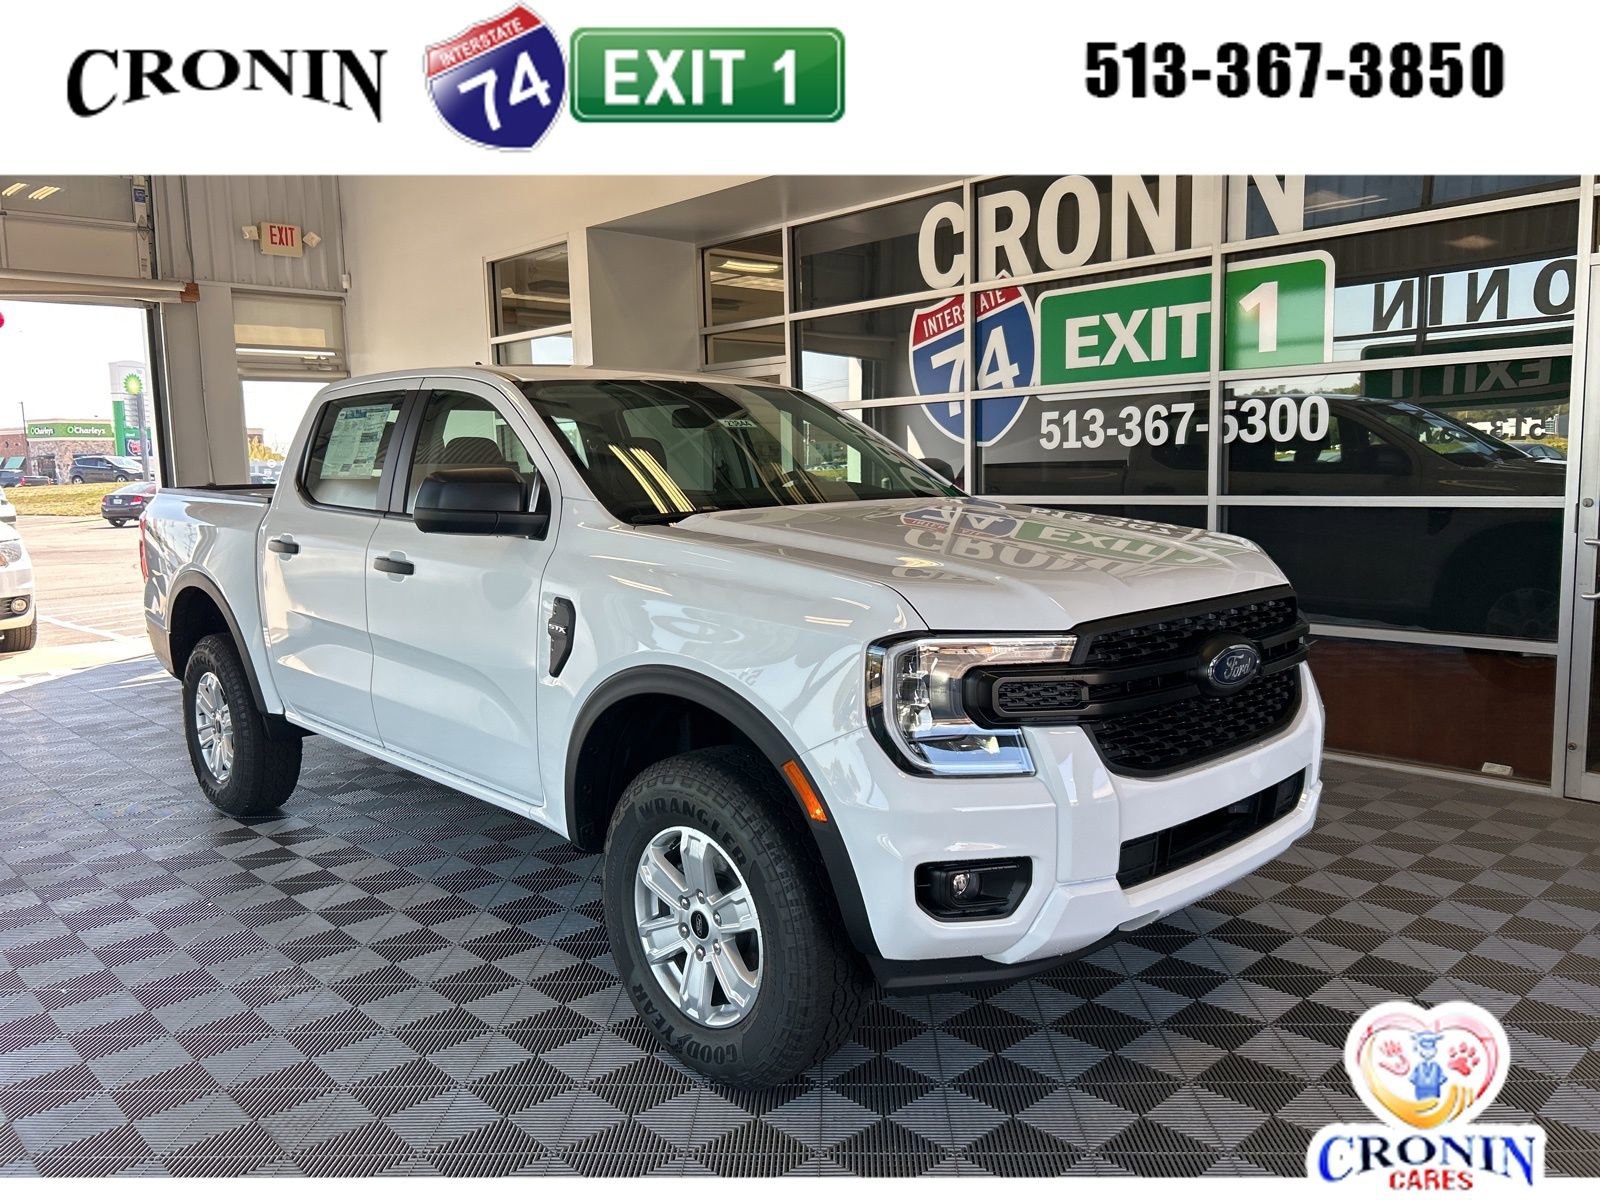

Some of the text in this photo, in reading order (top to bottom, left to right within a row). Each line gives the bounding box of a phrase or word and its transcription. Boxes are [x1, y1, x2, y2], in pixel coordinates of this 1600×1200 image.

[269, 224, 296, 247] EXIT
[918, 174, 1304, 289] CRONIN
[923, 289, 1006, 338] INTERATE
[1065, 281, 1279, 370] EXIT 1
[930, 325, 1020, 418] 74
[548, 623, 567, 634] STX
[1223, 653, 1251, 680] Ford
[639, 798, 747, 865] WRANGLER
[632, 983, 738, 1065] GOODYEAR
